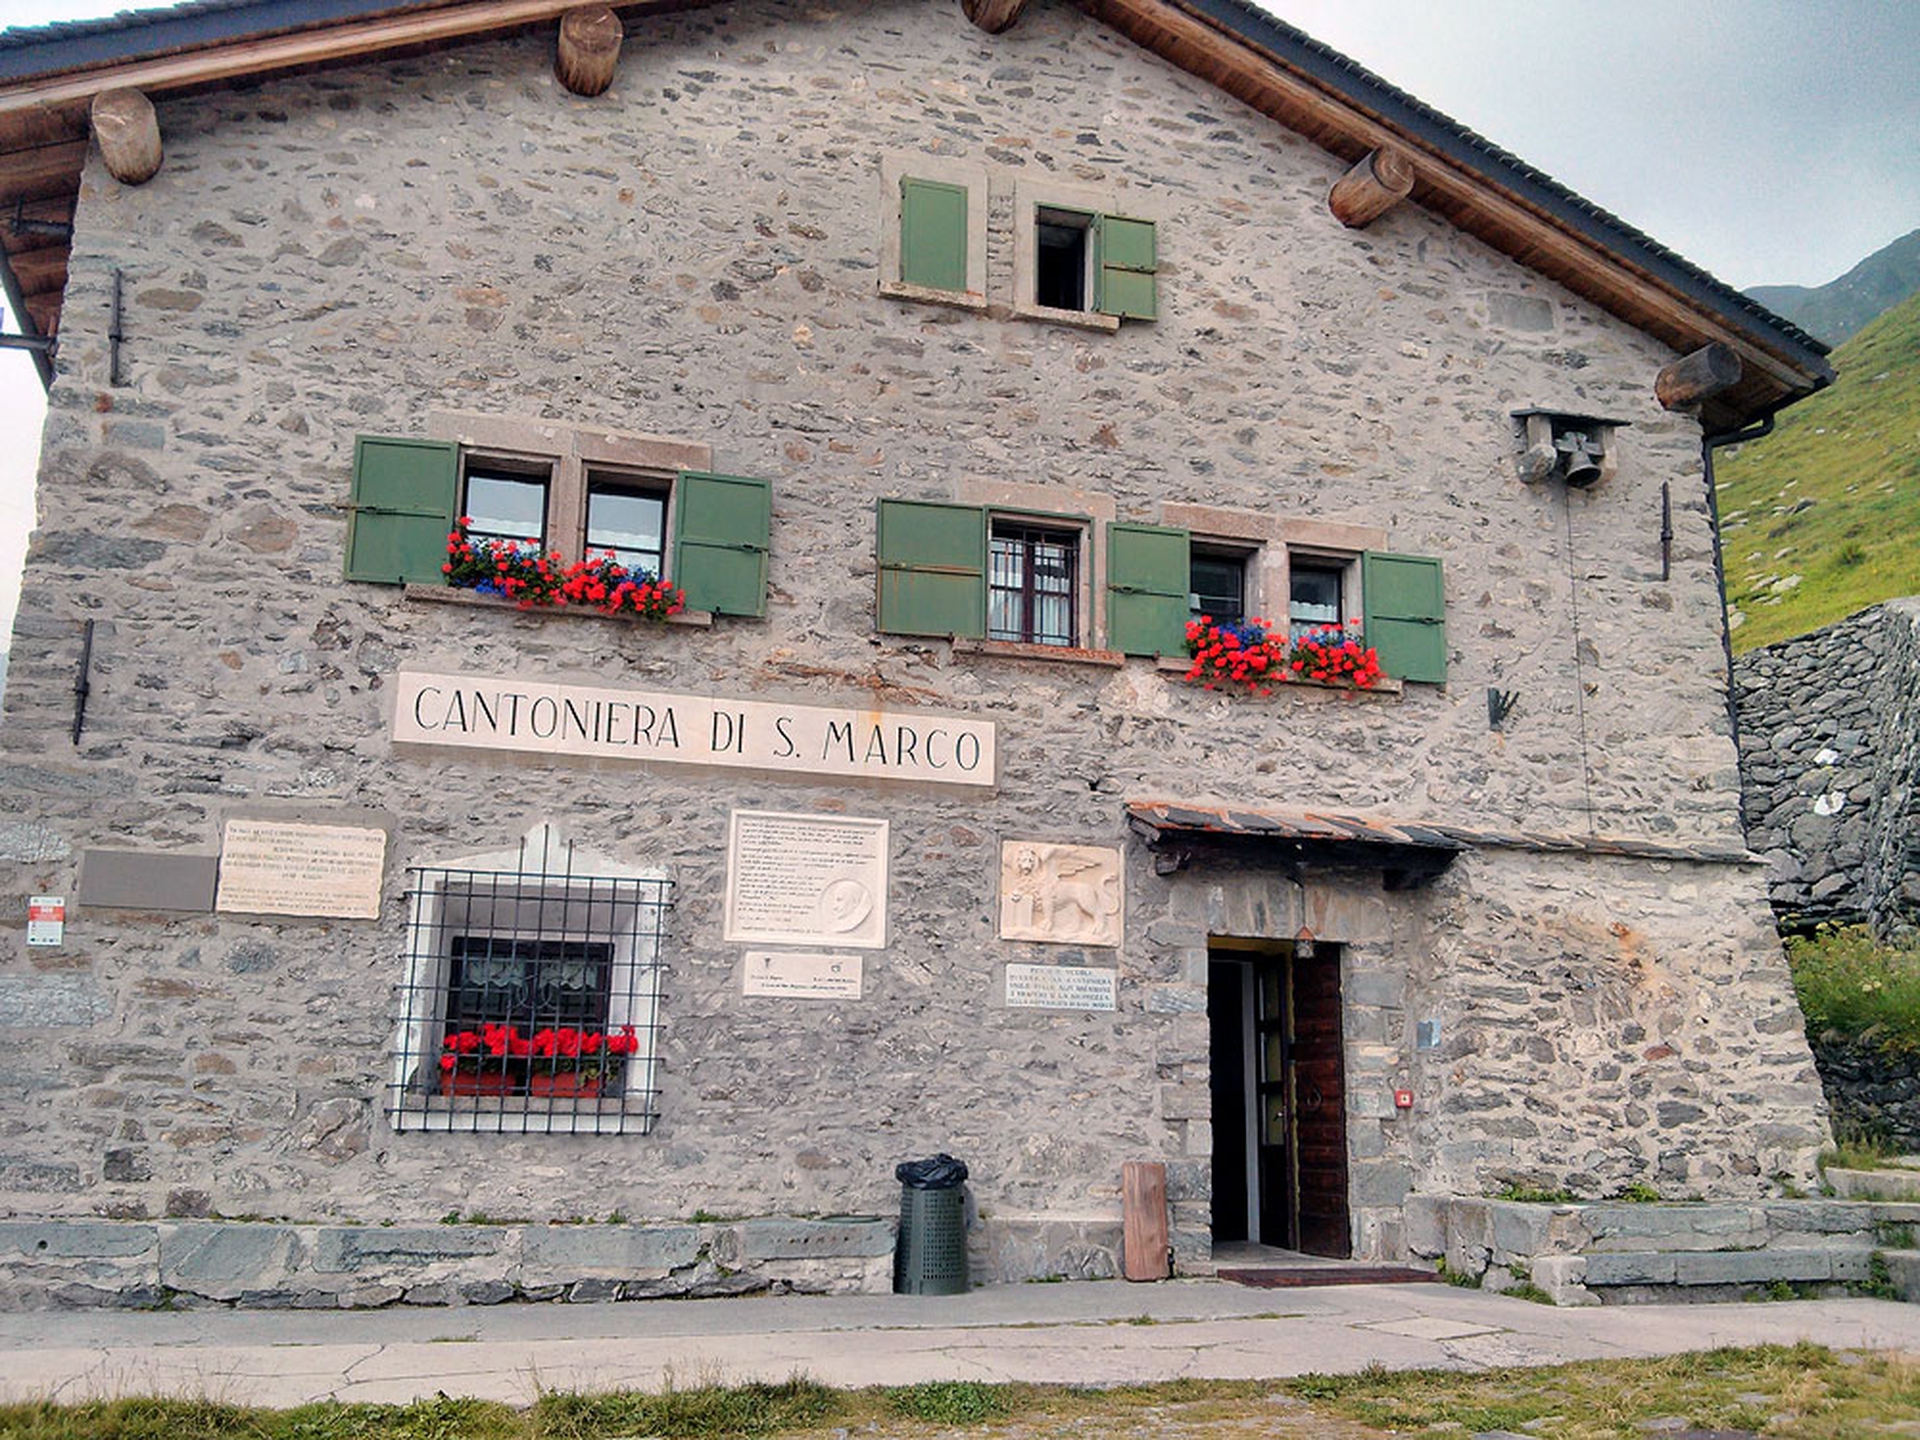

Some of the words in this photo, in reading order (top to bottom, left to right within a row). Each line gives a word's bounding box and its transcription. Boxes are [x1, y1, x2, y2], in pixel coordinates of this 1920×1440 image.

[414, 686, 680, 749] CANTONIERA
[711, 711, 745, 754] DI
[773, 716, 801, 759] S.
[822, 721, 981, 771] MARCO
